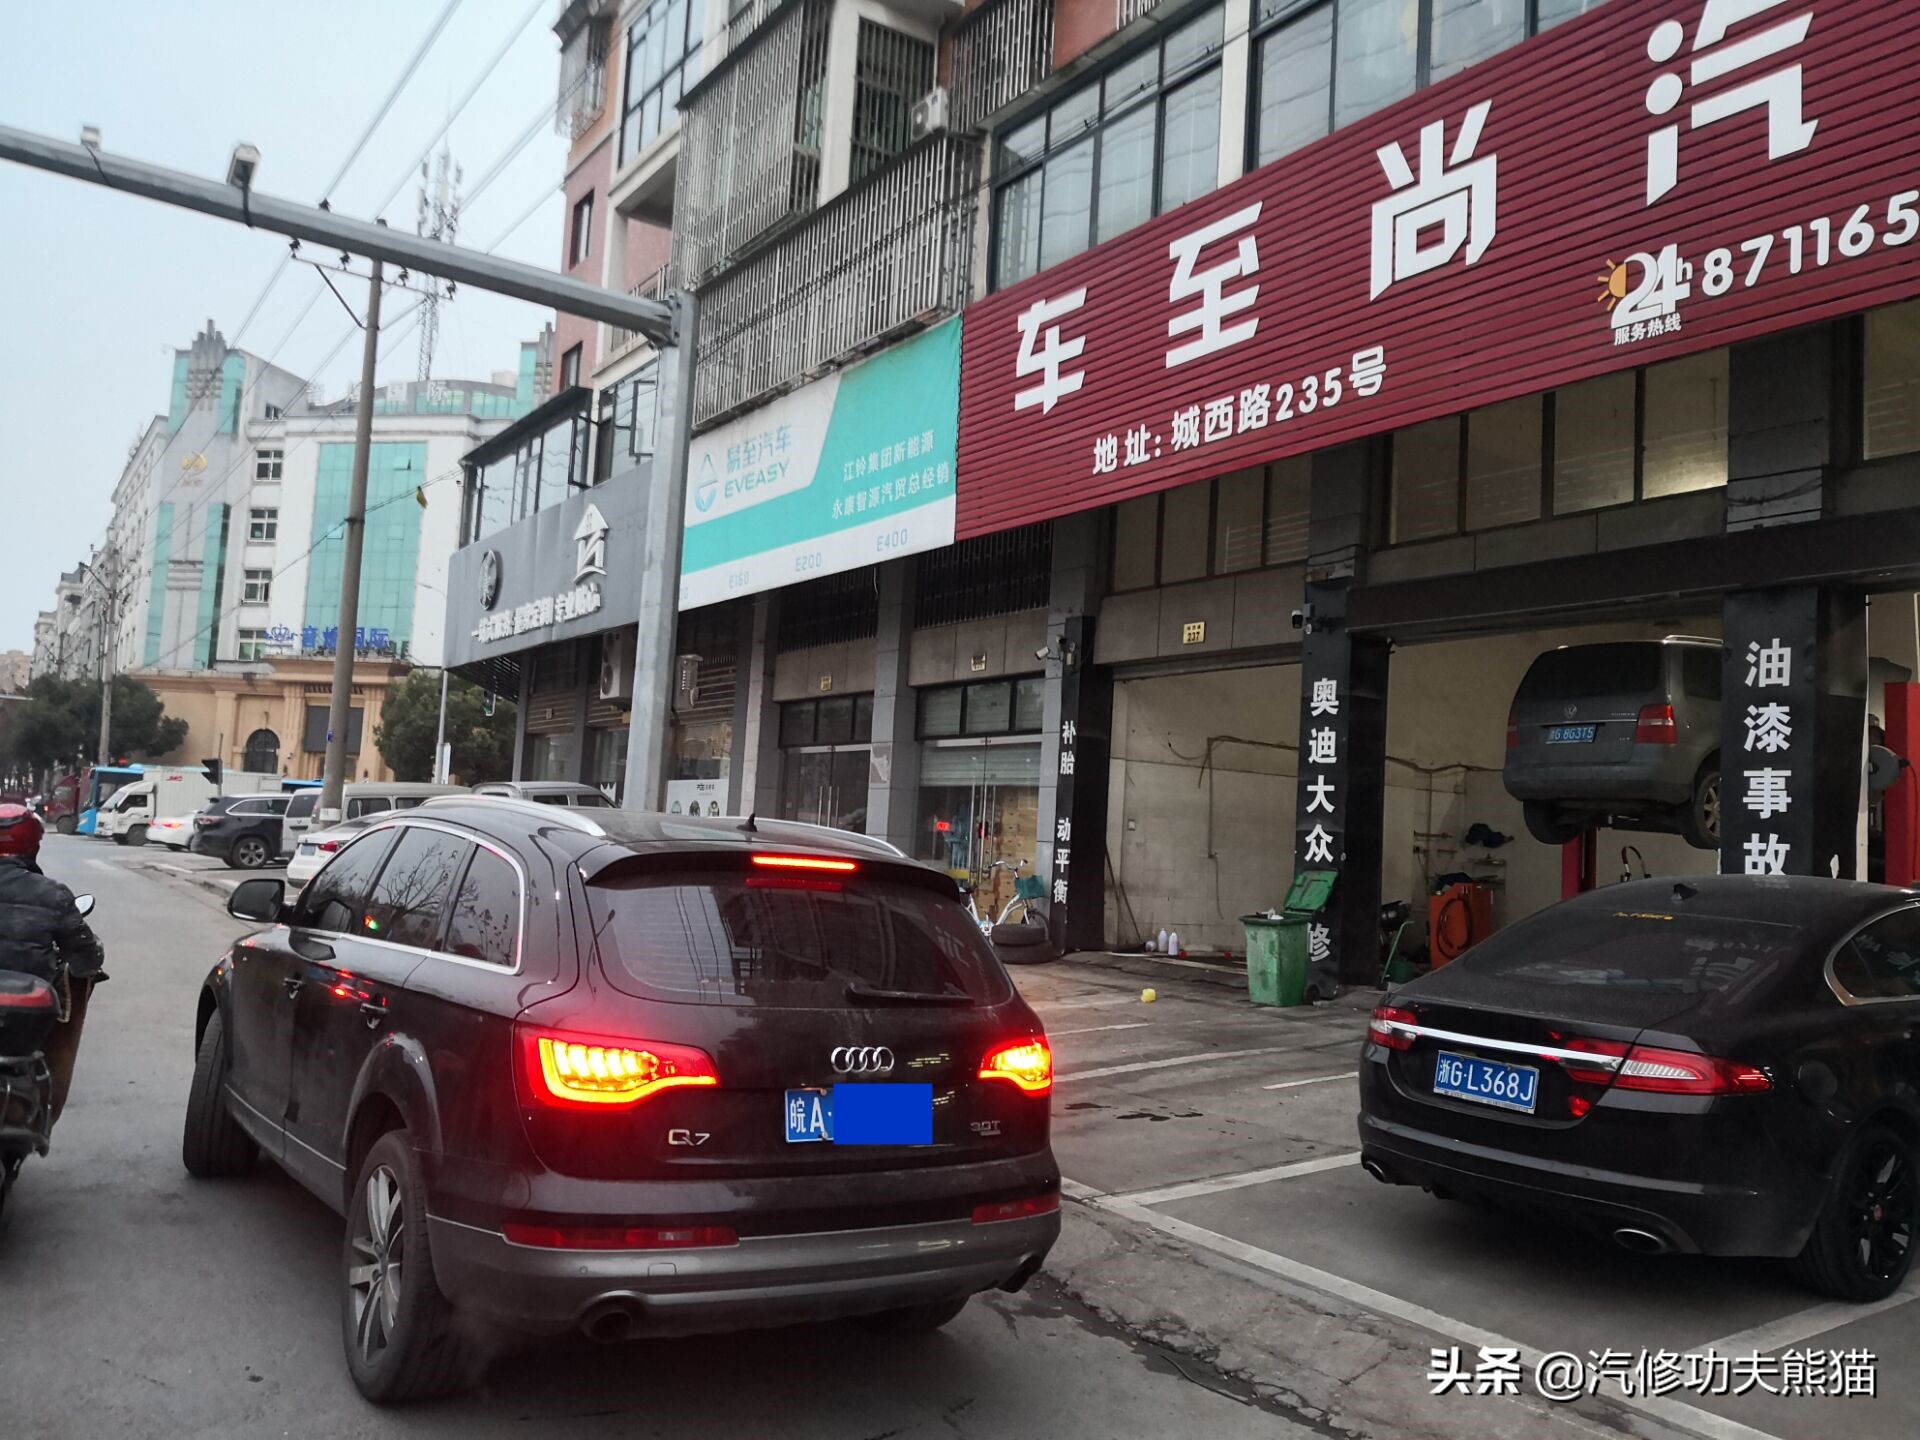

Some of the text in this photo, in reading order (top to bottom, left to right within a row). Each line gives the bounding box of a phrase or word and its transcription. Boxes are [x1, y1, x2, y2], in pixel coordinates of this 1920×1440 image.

[1702, 190, 1920, 297] 871165
[1614, 312, 1682, 346] 服务热线
[727, 425, 791, 474] 易至汽车
[843, 430, 934, 482] 江铃集团新能源
[725, 458, 790, 498] EVEASY
[832, 461, 950, 519] 永康智源汽贸总经销
[795, 552, 822, 572] E200
[877, 529, 908, 552] E400
[1743, 638, 1792, 875] 油漆事故
[1053, 720, 1076, 904] 补胎 动平衡
[1304, 678, 1339, 961] 奥迪大众修
[668, 1129, 710, 1147] Q7
